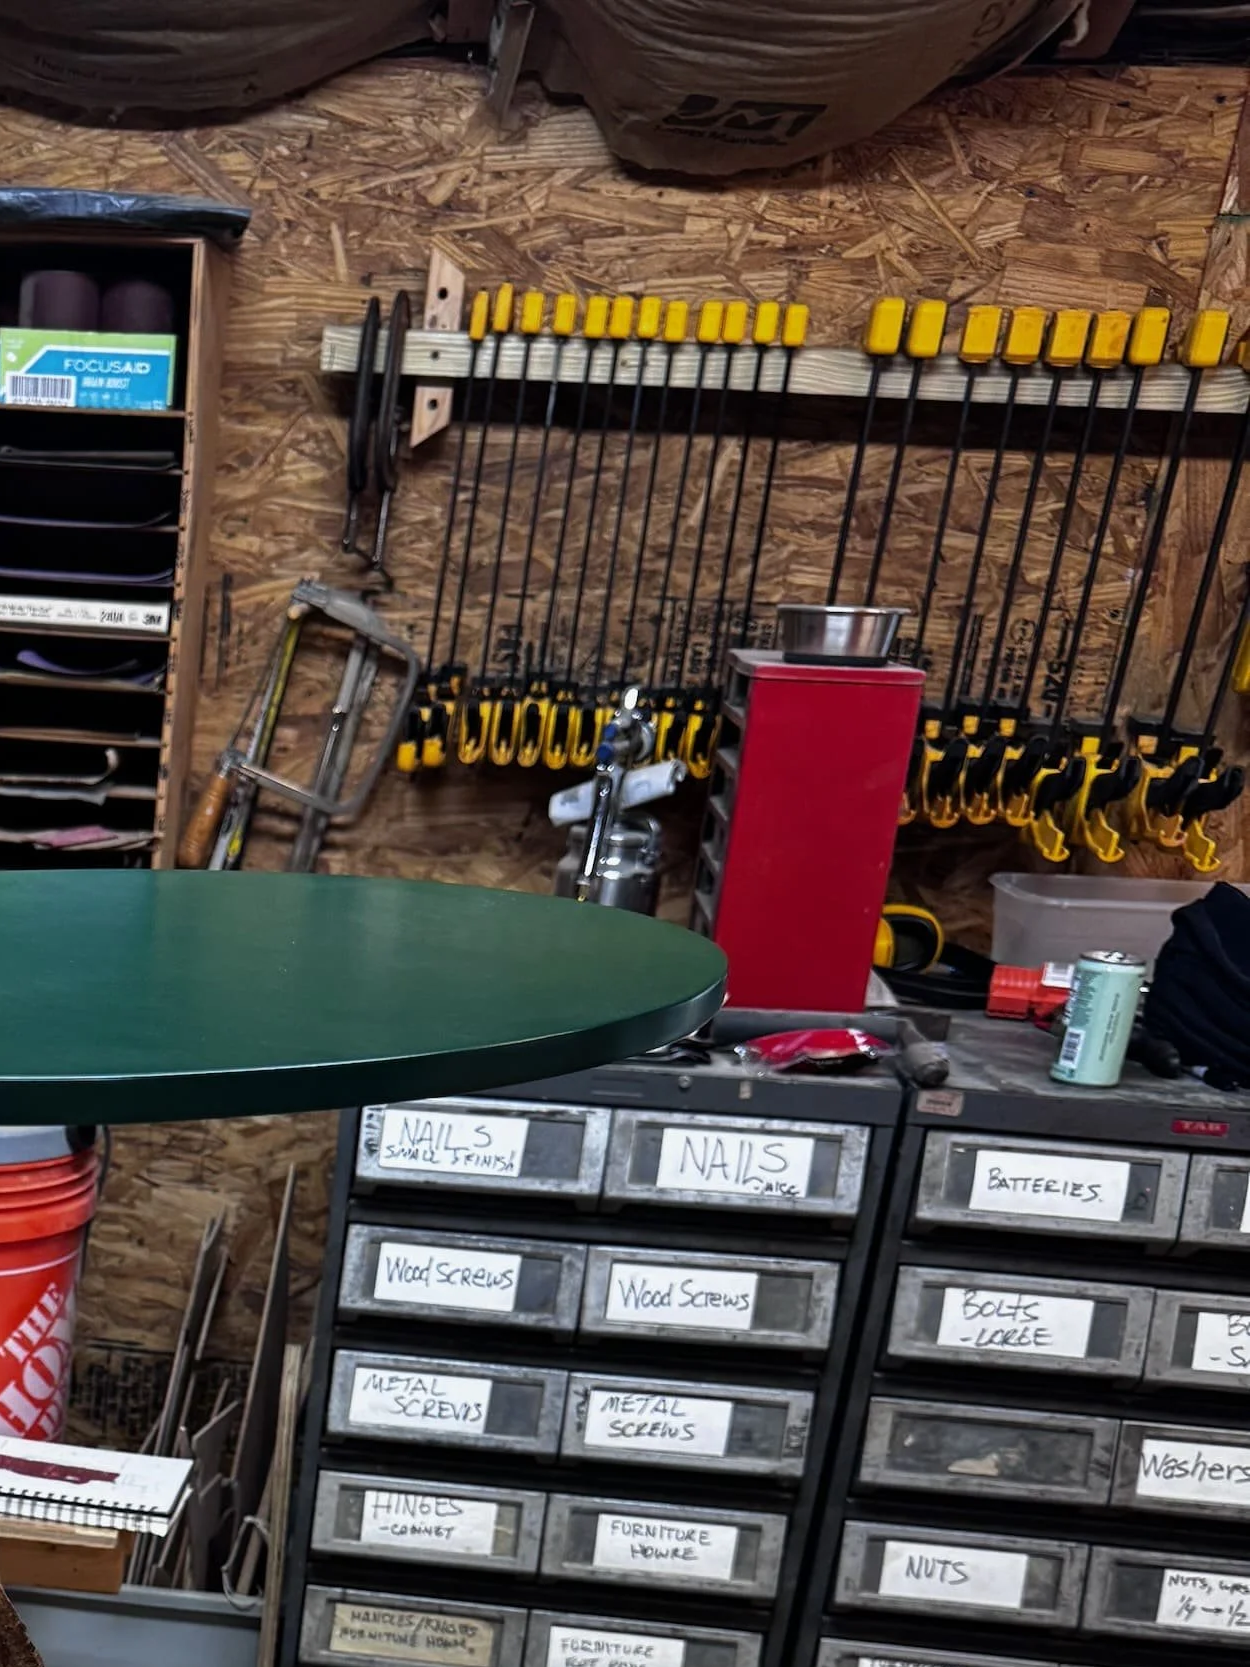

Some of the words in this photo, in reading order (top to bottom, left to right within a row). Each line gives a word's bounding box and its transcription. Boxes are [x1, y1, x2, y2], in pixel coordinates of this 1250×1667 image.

[64, 358, 151, 375] FOCUSAID
[399, 1117, 493, 1152] NAILS
[680, 1136, 788, 1185] NAILS
[987, 1166, 1103, 1203] BATTERIES.
[386, 1256, 431, 1288] Wood
[618, 1276, 671, 1310] Wood
[363, 1374, 447, 1397] METAL
[392, 1397, 483, 1422] SCREWS
[600, 1394, 686, 1418] METAL
[607, 1420, 696, 1442] SCREWS
[1141, 1450, 1250, 1484] Washers
[372, 1491, 464, 1520] HINGES
[610, 1519, 712, 1546] FURNITURE
[905, 1554, 969, 1586] NUTS
[561, 1637, 655, 1659] FURNITURE
